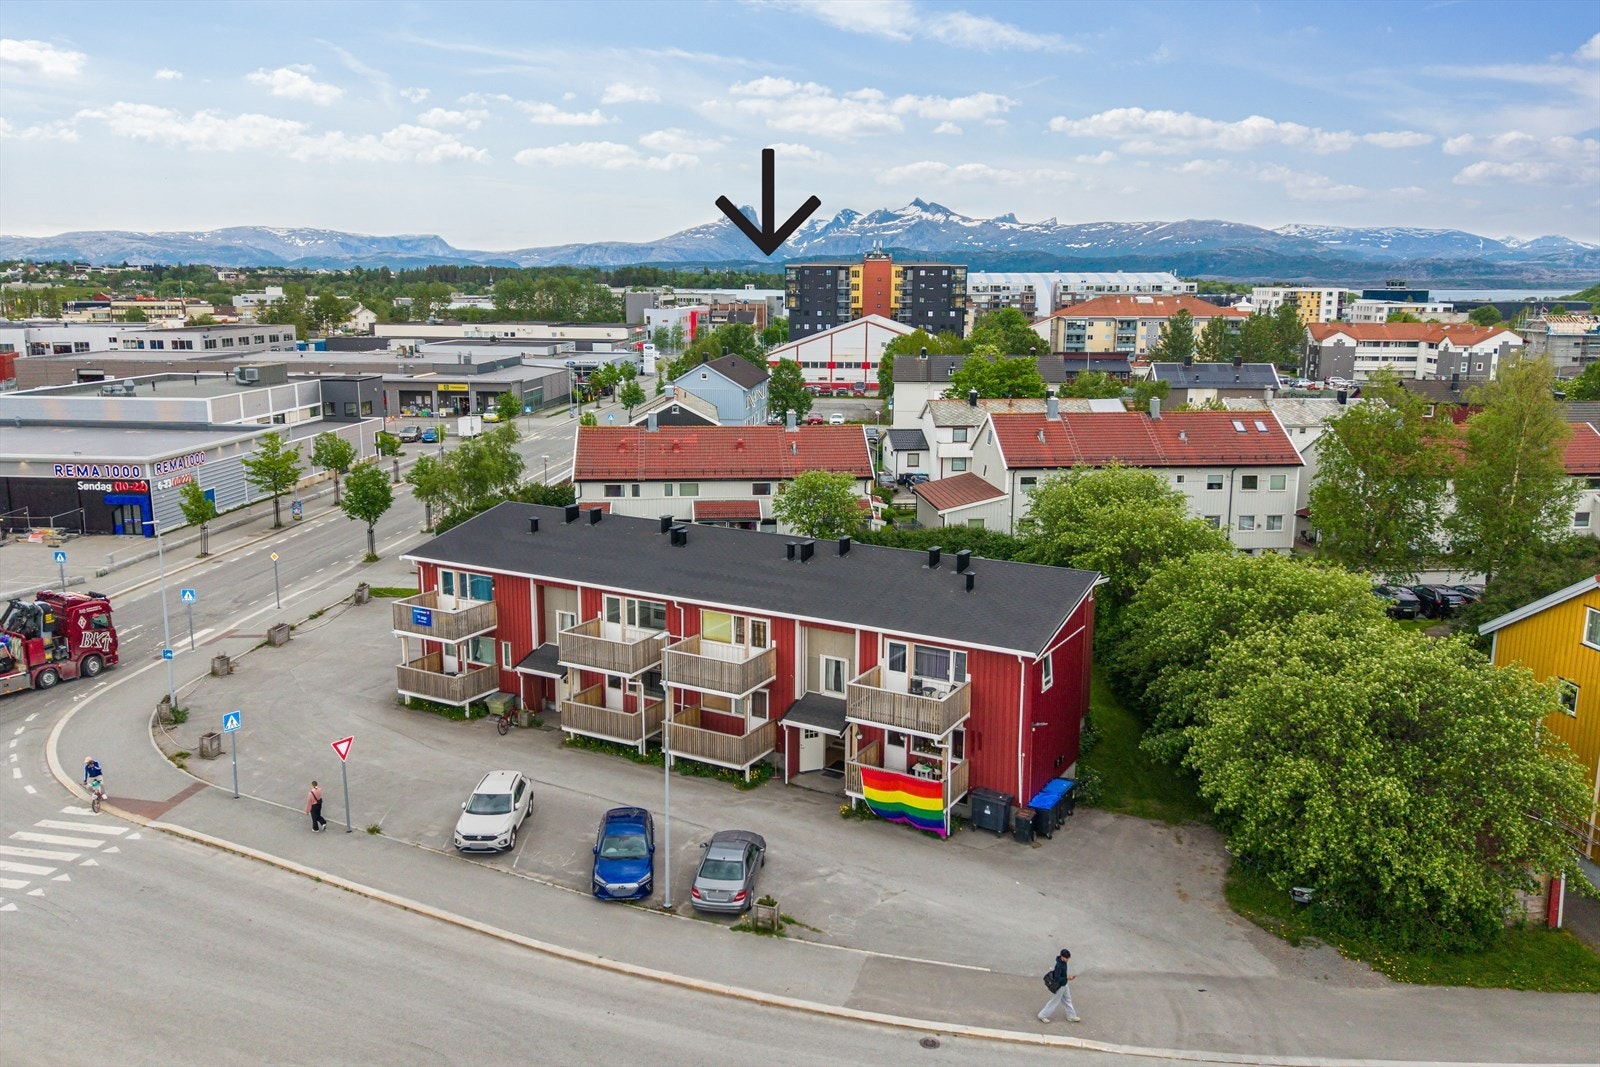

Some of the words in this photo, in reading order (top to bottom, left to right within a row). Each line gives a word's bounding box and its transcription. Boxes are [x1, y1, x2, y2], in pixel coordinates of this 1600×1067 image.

[155, 457, 184, 475] REMA
[185, 451, 205, 467] 1000
[54, 464, 100, 478] REMA
[105, 465, 141, 478] 1000
[77, 481, 112, 492] Søndag
[113, 480, 148, 492] (10-22)
